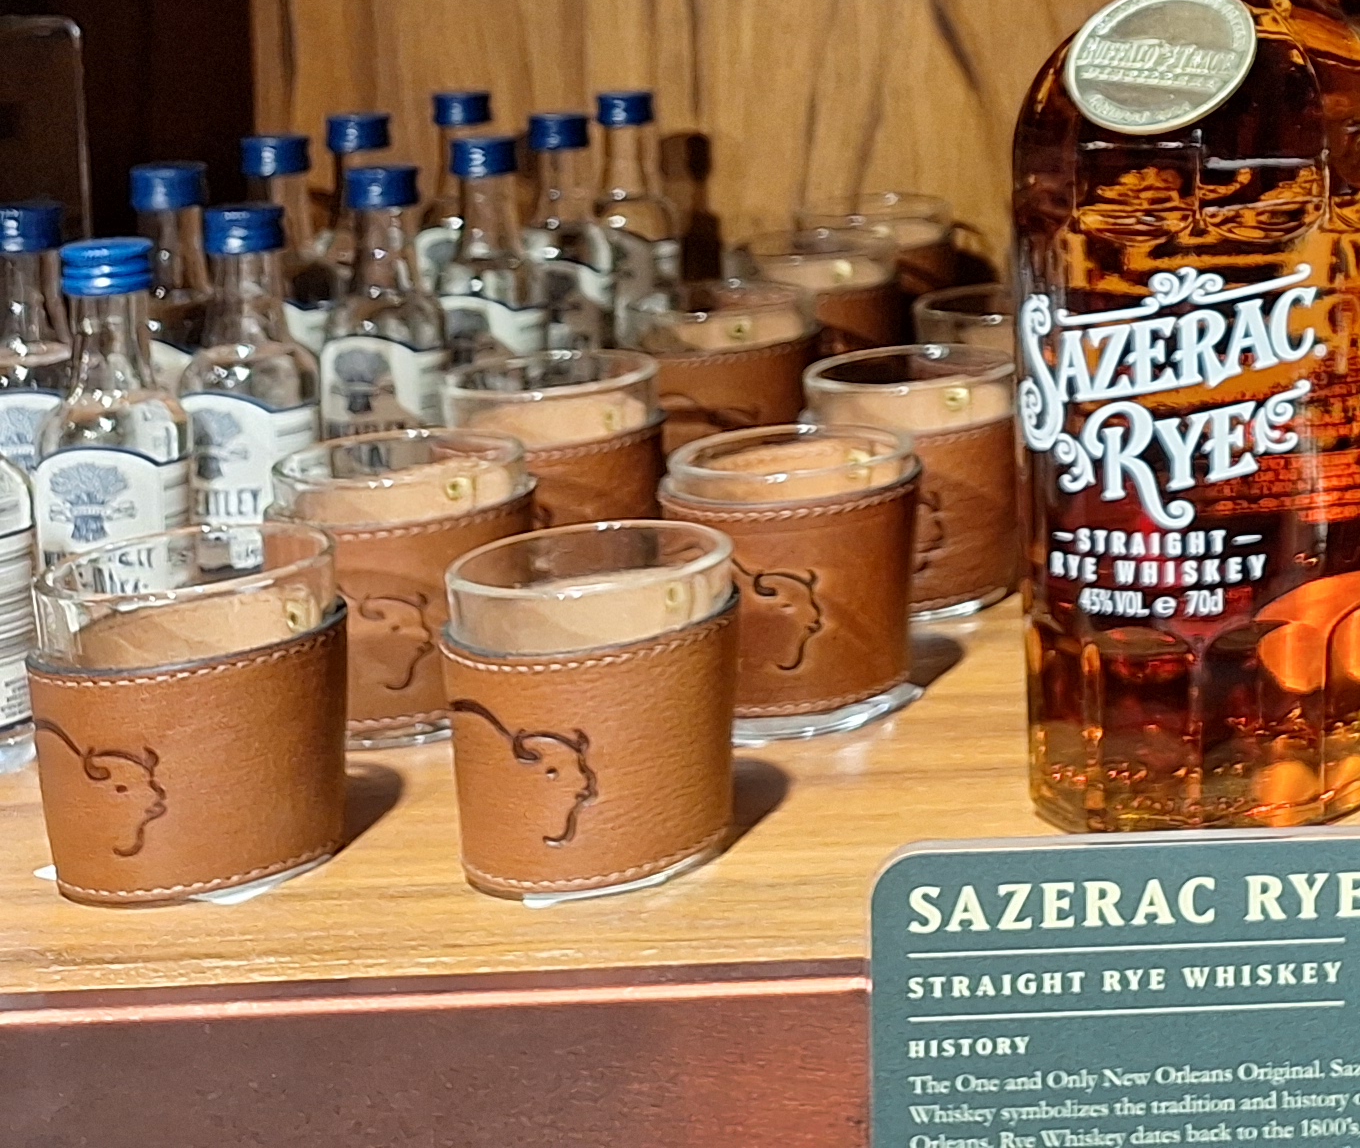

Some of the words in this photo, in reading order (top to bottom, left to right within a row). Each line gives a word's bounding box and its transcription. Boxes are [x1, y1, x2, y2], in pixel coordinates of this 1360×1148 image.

[1019, 286, 1318, 451] SAZERAC
[1080, 397, 1262, 528] RYE
[1074, 528, 1227, 557] STRAIGHT
[1050, 551, 1098, 583] RYE
[1114, 554, 1267, 586] WHISKEY
[1112, 591, 1150, 617] VOL
[907, 876, 1216, 934] SAZERAC
[907, 971, 1086, 999] STRAIGHT
[1102, 968, 1167, 992] RYE
[1183, 961, 1344, 989] WHISKEY
[907, 1035, 1031, 1058] HISTORY
[907, 1075, 951, 1094] The
[955, 1074, 1000, 1092] One
[1003, 1071, 1042, 1091] and
[1046, 1068, 1098, 1094] Only
[1102, 1067, 1151, 1088] New
[1154, 1064, 1233, 1084] Orleans
[909, 1104, 997, 1126] Whiskey
[1000, 1100, 1110, 1126] symbolizes
[1113, 1097, 1147, 1116] the
[1150, 1094, 1235, 1114] tradition
[1240, 1091, 1277, 1111] and
[1281, 1089, 1350, 1112] history
[1000, 1132, 1037, 1148] Rye
[1040, 1127, 1127, 1148] Whiskey
[1129, 1125, 1182, 1145] dates
[1185, 1123, 1232, 1143] back
[1236, 1125, 1258, 1141] to
[1262, 1121, 1295, 1140] the
